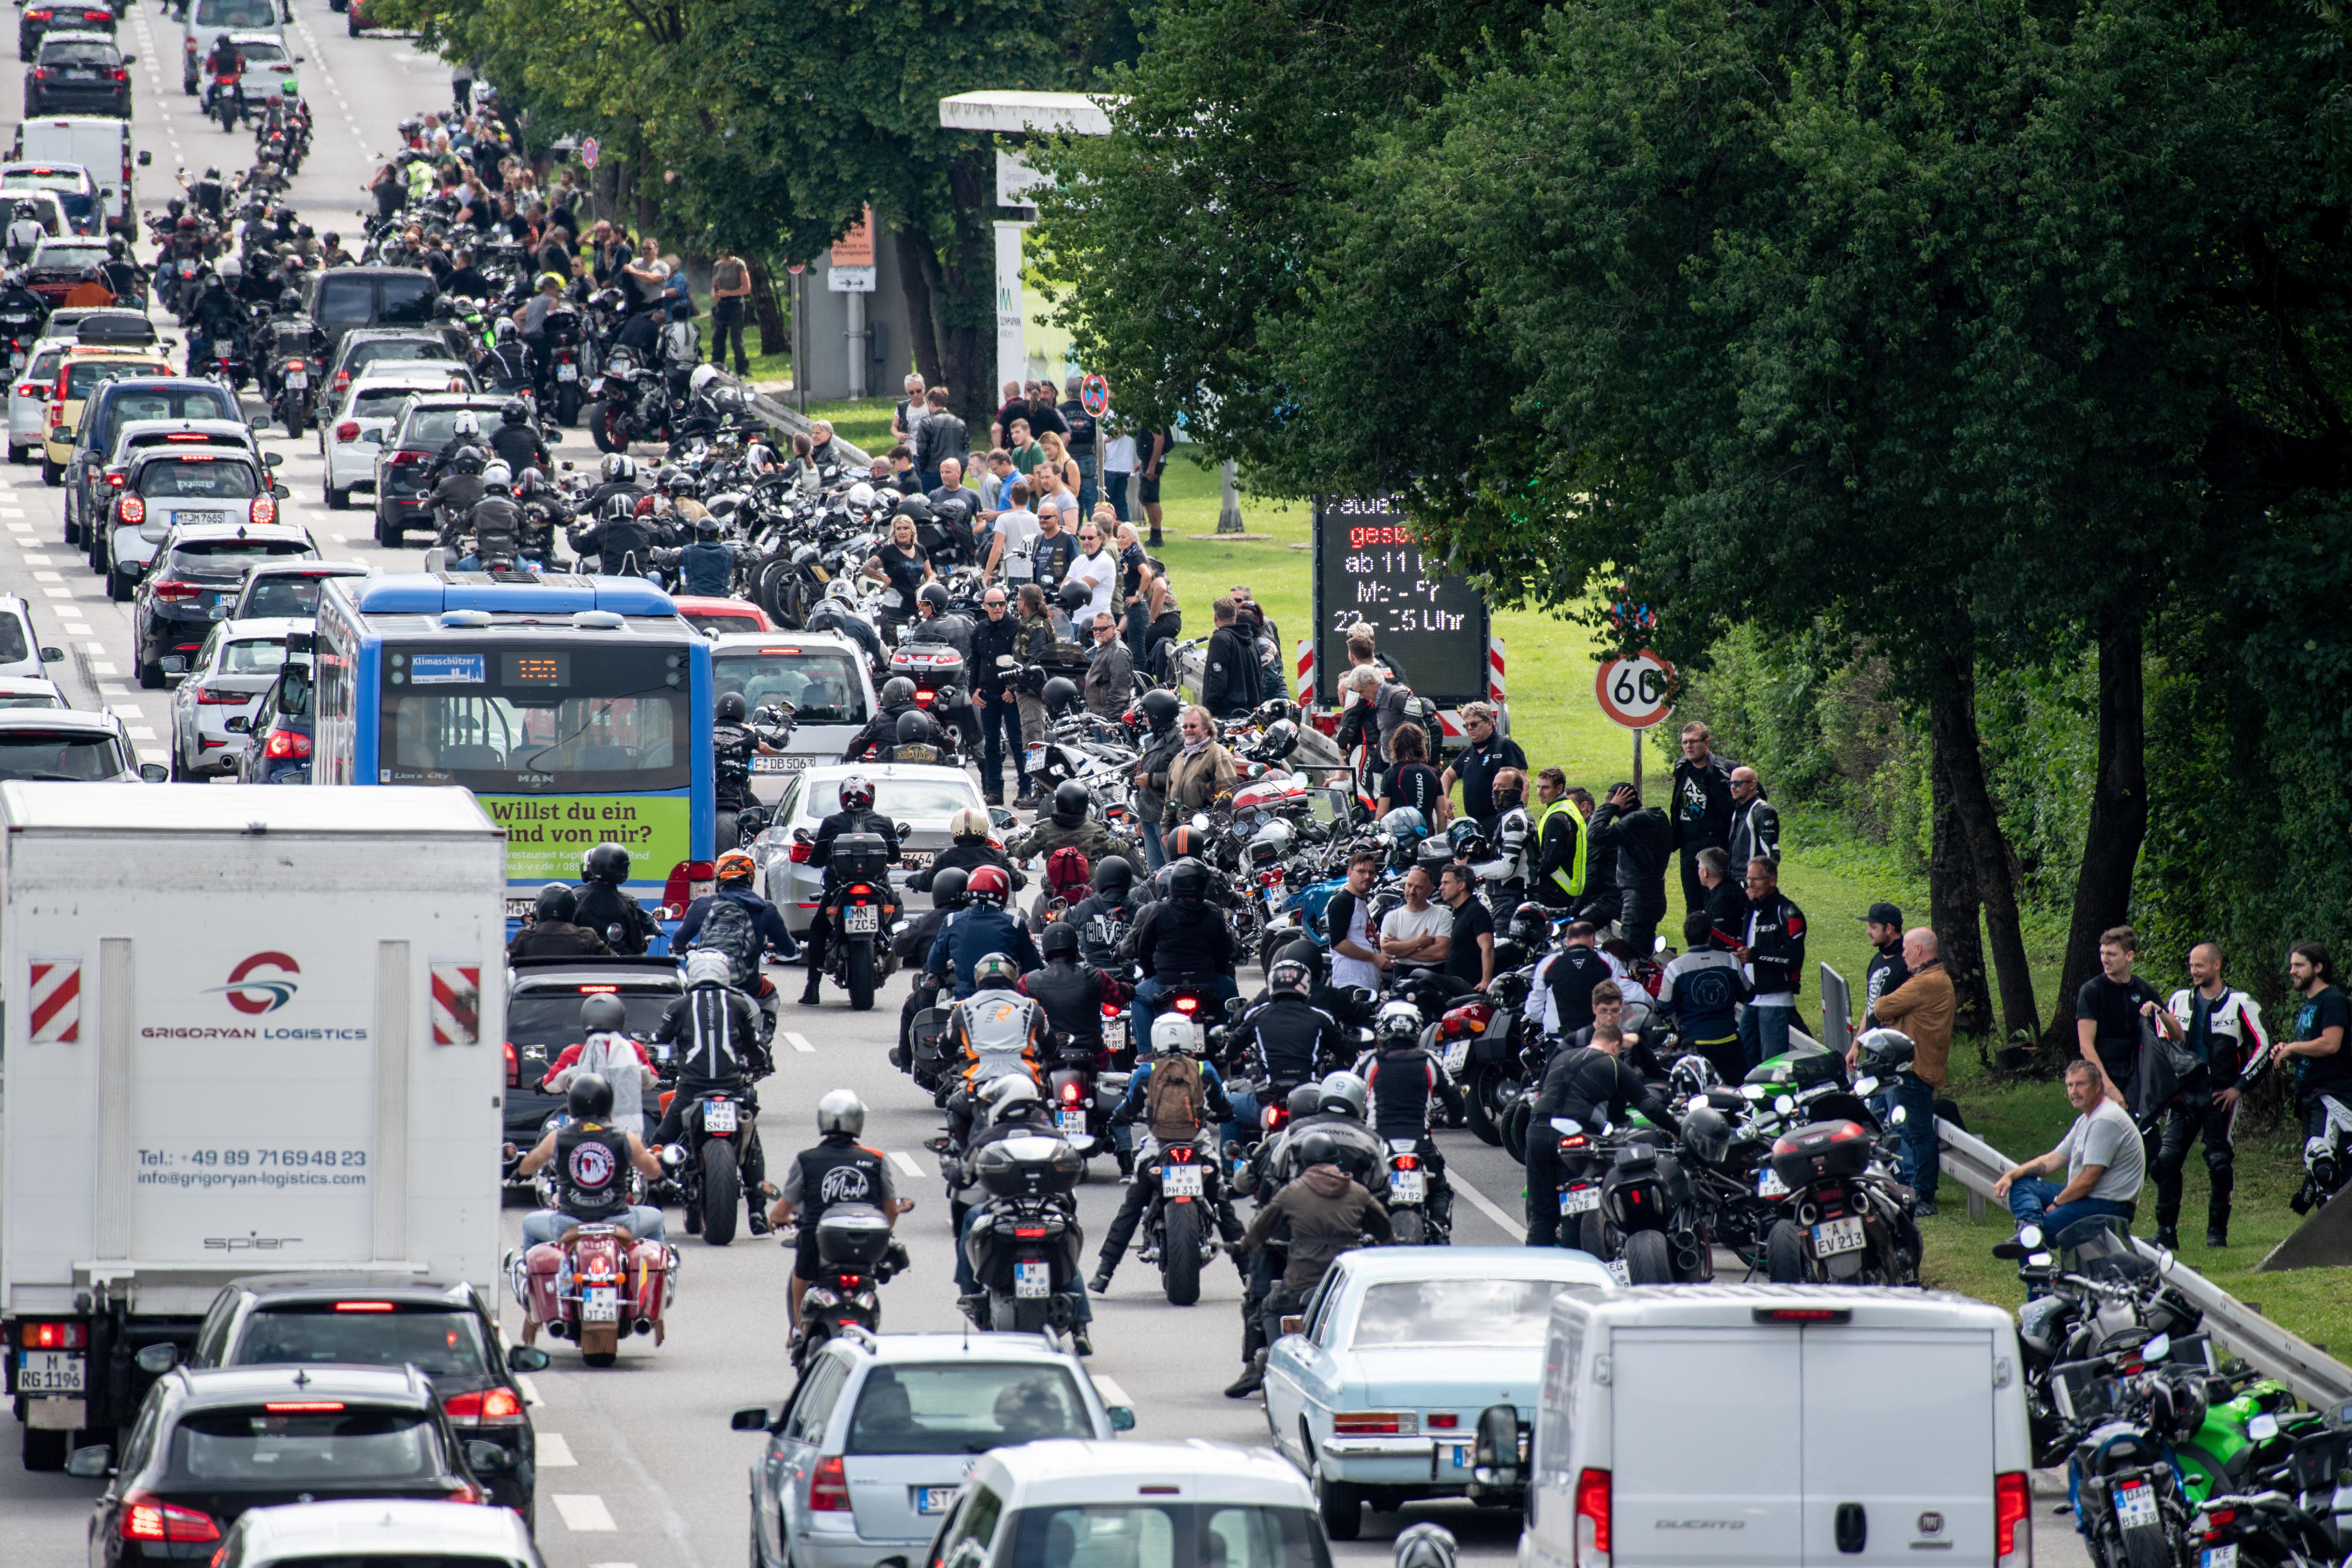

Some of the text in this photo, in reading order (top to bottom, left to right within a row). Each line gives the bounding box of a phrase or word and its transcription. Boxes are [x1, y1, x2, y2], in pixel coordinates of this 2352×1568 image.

[1000, 317, 1022, 326] OLYMPIAPARK
[177, 514, 182, 522] M
[202, 513, 222, 523] 7685
[1345, 552, 1374, 573] ab
[1382, 550, 1406, 573] 11
[1424, 609, 1465, 631] Uhr
[413, 657, 475, 666] Klimaschützer
[1614, 668, 1660, 705] 60
[755, 758, 762, 769] F
[771, 758, 785, 769] DB
[787, 758, 813, 769] 5063
[1031, 761, 1043, 770] 701
[491, 802, 636, 821] Willst du ein
[498, 825, 652, 843] ind von mir?
[628, 851, 649, 860] Rind
[507, 862, 554, 871] w.k-v-r.de
[506, 902, 514, 914] M
[851, 908, 867, 919] MN
[855, 919, 876, 930] ZC 5
[1759, 956, 1790, 964] DAINESE
[1109, 1023, 1120, 1031] BC
[142, 1027, 367, 1040] GRIGORYAN LOGISTICS
[138, 1149, 173, 1166] Tel.:
[179, 1150, 217, 1166] +49
[223, 1150, 249, 1166] 89
[342, 1150, 366, 1166] 23
[138, 1170, 366, 1189] info@grigoryan-logistics.com
[1183, 1185, 1200, 1194] 317
[1773, 1184, 1785, 1192] 65
[1568, 1193, 1579, 1203] GZ
[1832, 1223, 1840, 1236] A
[204, 1231, 304, 1252] spier
[1818, 1232, 1863, 1254] EV 213
[1609, 1261, 1623, 1272] EG
[1035, 1287, 1047, 1296] 65
[47, 1354, 57, 1370] M
[21, 1371, 80, 1388] RG 1196
[2126, 1488, 2151, 1501] DAH
[1655, 1520, 1745, 1529] DUCATO
[2122, 1515, 2138, 1527] BS
[2215, 1547, 2229, 1561] KE
